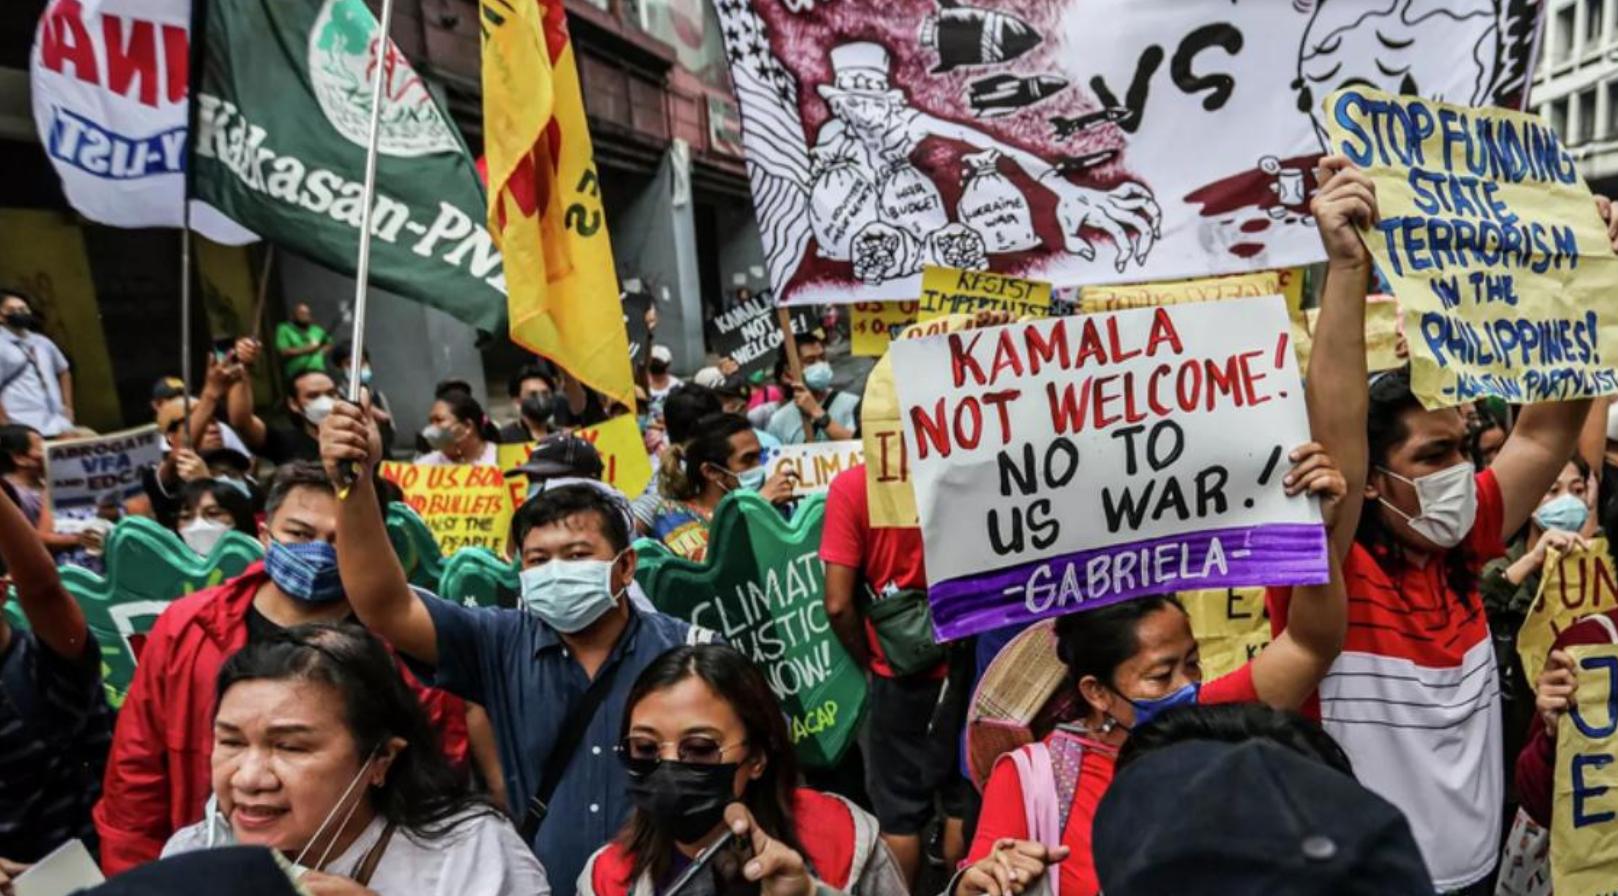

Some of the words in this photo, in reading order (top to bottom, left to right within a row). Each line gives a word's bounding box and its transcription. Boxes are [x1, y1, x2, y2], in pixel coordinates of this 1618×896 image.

[1090, 22, 1243, 133] VS
[1334, 91, 1435, 168] STOP
[1438, 108, 1577, 185] FUNDING
[1408, 166, 1519, 226] STATE
[1375, 216, 1578, 277] TERRORISM
[1430, 277, 1461, 310] IN
[1468, 271, 1518, 306] THE
[741, 312, 774, 342] NOT
[948, 307, 1183, 388] KAMALA
[1420, 310, 1601, 369] PHILIPPINES!
[909, 388, 1021, 459] NOT
[1046, 332, 1288, 435] WELCOME!
[383, 463, 418, 489] NO
[427, 465, 459, 490] US
[998, 437, 1079, 496] NO
[1112, 420, 1185, 476] TO
[428, 494, 503, 514] BULLETS
[465, 516, 494, 531] THE
[987, 499, 1060, 556] US
[1101, 445, 1283, 532] WAR!
[691, 551, 826, 638] CLIMAT
[1003, 535, 1252, 613] -GABRIELA-
[1534, 556, 1618, 613] UN
